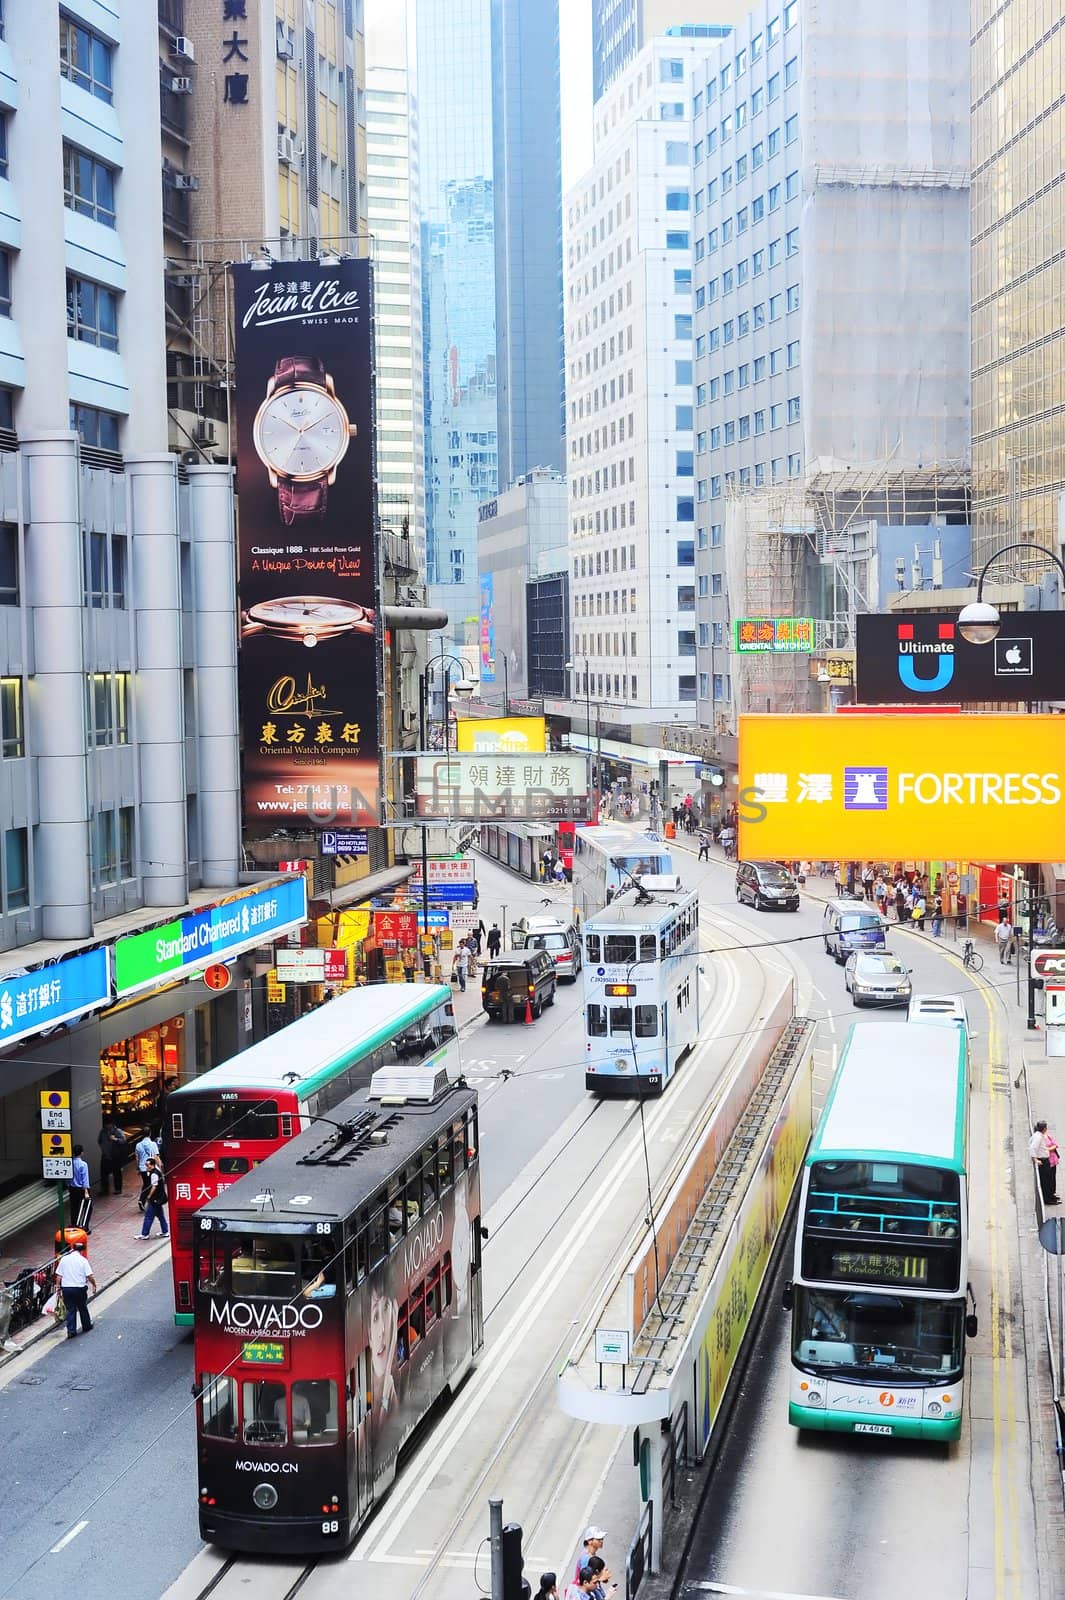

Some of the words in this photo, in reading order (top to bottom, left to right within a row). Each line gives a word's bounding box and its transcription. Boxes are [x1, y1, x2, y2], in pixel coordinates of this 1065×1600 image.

[242, 282, 299, 328] Jean
[251, 546, 284, 556] Classique
[286, 545, 303, 554] 1888
[251, 559, 260, 571] A
[262, 559, 292, 574] Unique
[292, 558, 326, 571] Point
[327, 557, 337, 573] of
[338, 555, 361, 571] View
[740, 642, 774, 651] ORIENTAL
[899, 642, 955, 654] Ultimate
[260, 721, 361, 745] 東方表行
[260, 745, 293, 755] Oriental
[294, 745, 320, 755] Watch
[321, 745, 361, 757] Company
[468, 764, 572, 787] 領達財務
[324, 784, 349, 795] 393
[752, 772, 833, 804] 豐澤
[897, 772, 1062, 806] FORTRESS
[250, 899, 278, 925] 渣打銀行
[155, 928, 199, 964] Standard
[198, 911, 241, 945] Chartered
[15, 979, 62, 1018] 渣打銀行
[49, 1110, 63, 1118] End
[200, 1218, 212, 1230] 88
[316, 1222, 331, 1235] 88
[404, 1210, 445, 1284] MOVADO
[903, 1256, 926, 1279] 111
[209, 1298, 324, 1329] MOVADO
[223, 1326, 251, 1337] MODERN
[271, 1329, 282, 1337] OF
[283, 1329, 292, 1337] ITS
[292, 1329, 307, 1337] TIME
[235, 1460, 299, 1474] MOVADO.CN
[322, 1521, 339, 1534] 88
